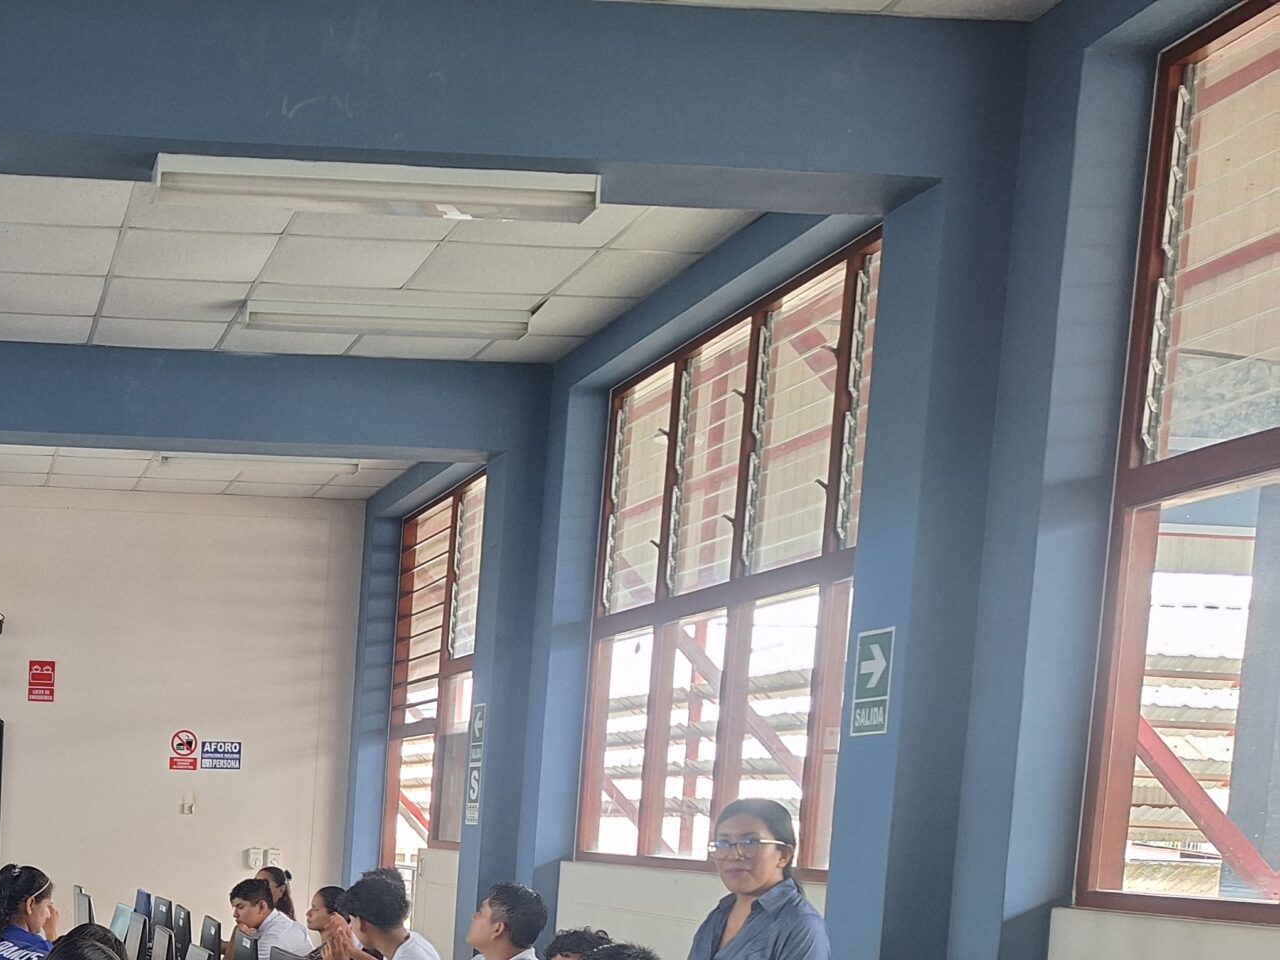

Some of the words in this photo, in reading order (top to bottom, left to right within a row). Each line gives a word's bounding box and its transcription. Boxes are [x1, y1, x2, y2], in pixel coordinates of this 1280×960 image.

[854, 706, 884, 727] SALIDA
[203, 742, 240, 753] AFORO
[213, 759, 240, 768] PERSONA
[470, 770, 479, 800] S
